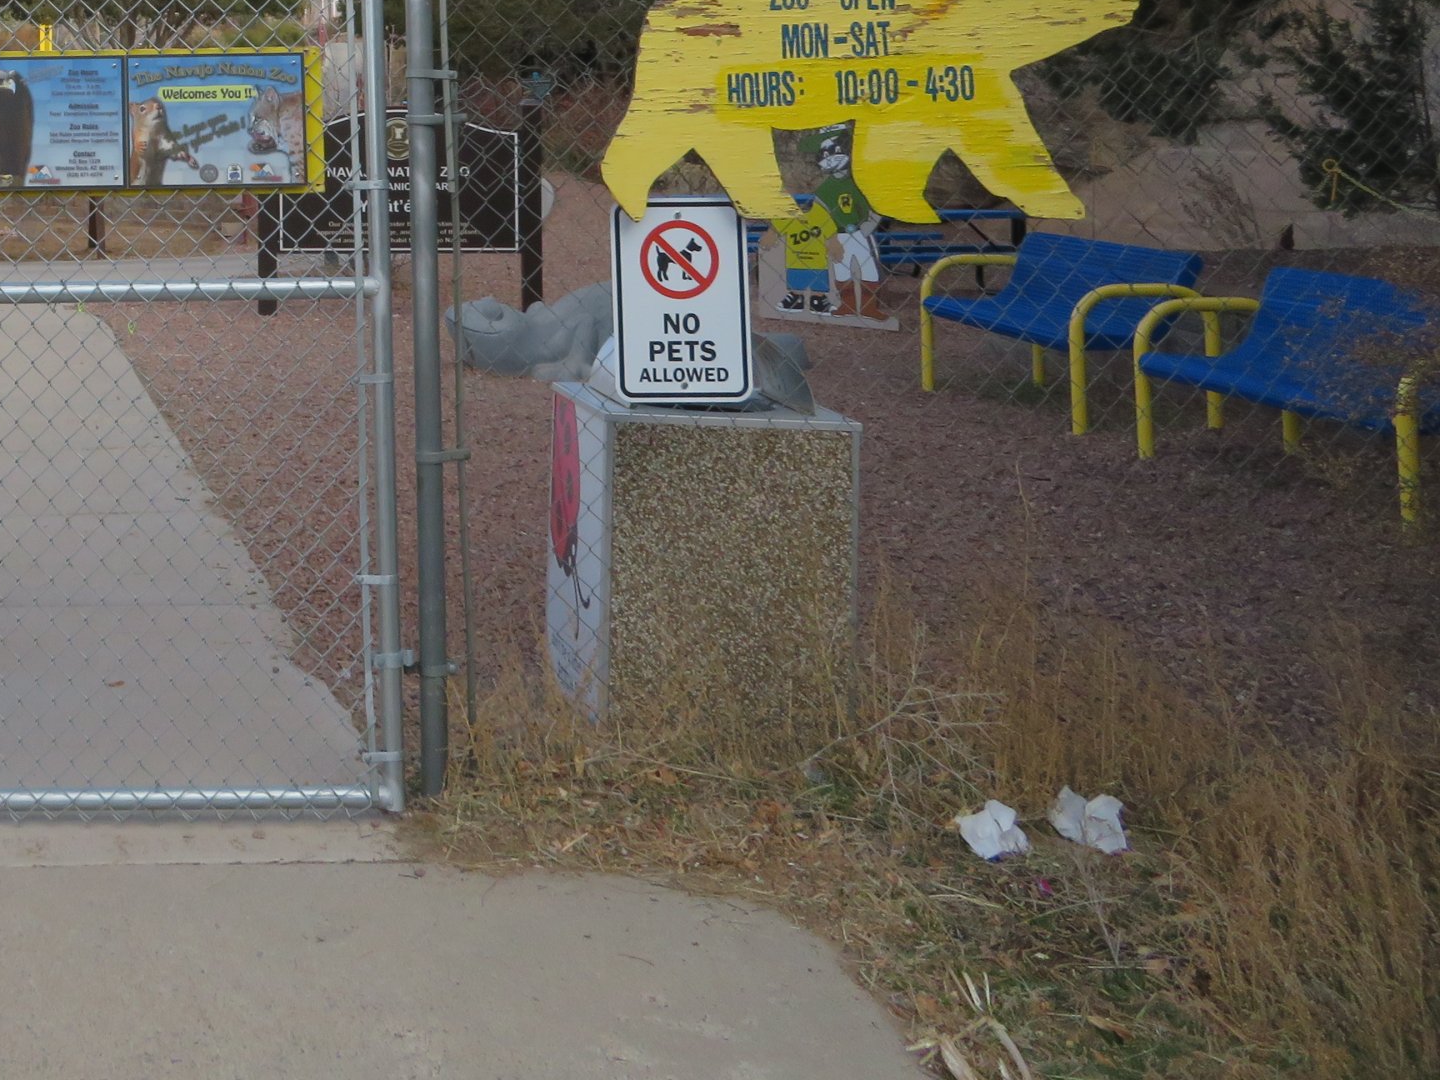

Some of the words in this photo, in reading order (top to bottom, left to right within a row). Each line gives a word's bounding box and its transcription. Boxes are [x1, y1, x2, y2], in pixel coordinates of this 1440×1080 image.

[134, 70, 164, 87] The
[162, 65, 213, 80] Navajo
[217, 62, 266, 79] Nation
[269, 67, 297, 85] Zoo
[162, 88, 217, 100] Welcomes
[220, 87, 241, 99] You
[727, 70, 804, 107] HOURS:
[73, 150, 96, 158] Contact
[440, 166, 470, 177] ZO
[790, 226, 822, 245] ZOO
[663, 313, 700, 334] NO
[649, 340, 717, 362] PETS
[639, 367, 729, 382] ALLOWED
